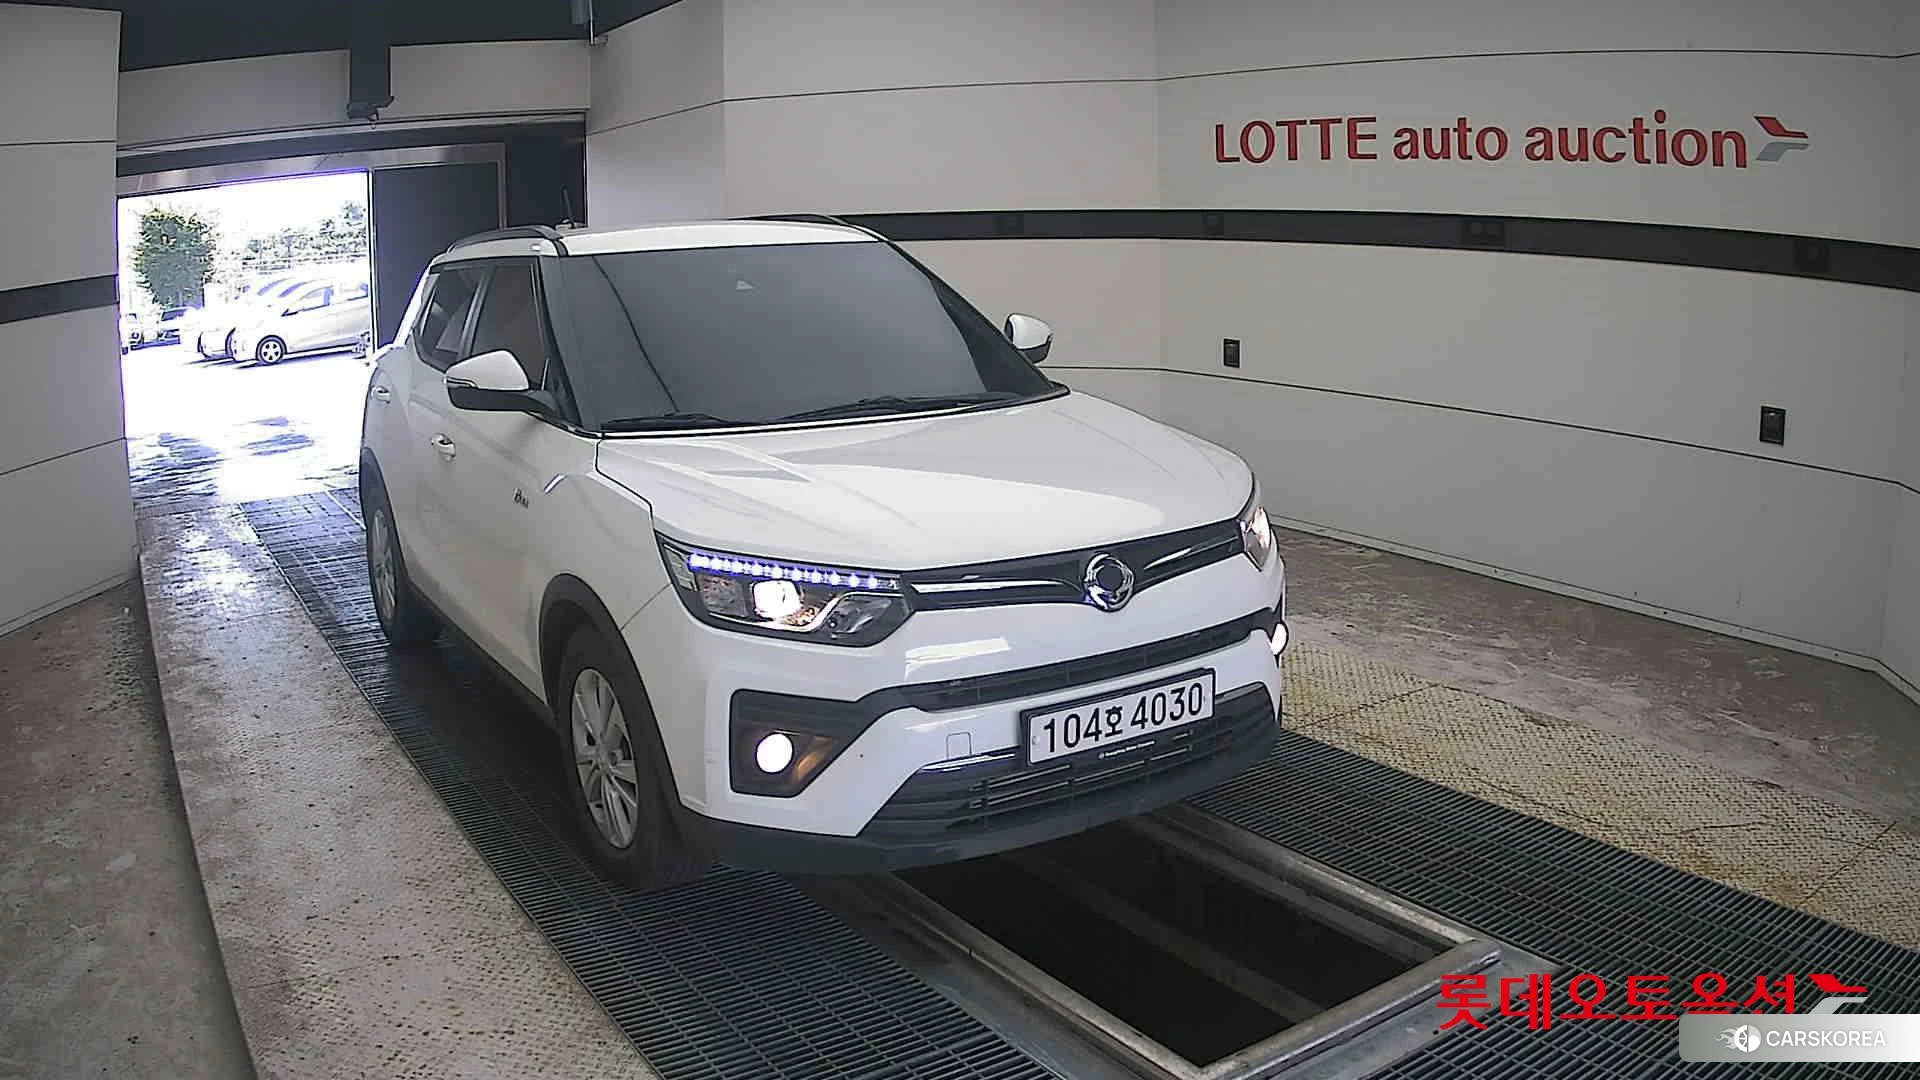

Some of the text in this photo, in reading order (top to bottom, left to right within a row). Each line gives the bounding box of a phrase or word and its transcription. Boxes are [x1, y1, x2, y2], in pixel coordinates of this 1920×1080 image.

[1215, 109, 1748, 168] LOTTE auto auction
[1043, 705, 1123, 752] 104호
[1130, 682, 1203, 730] 4030
